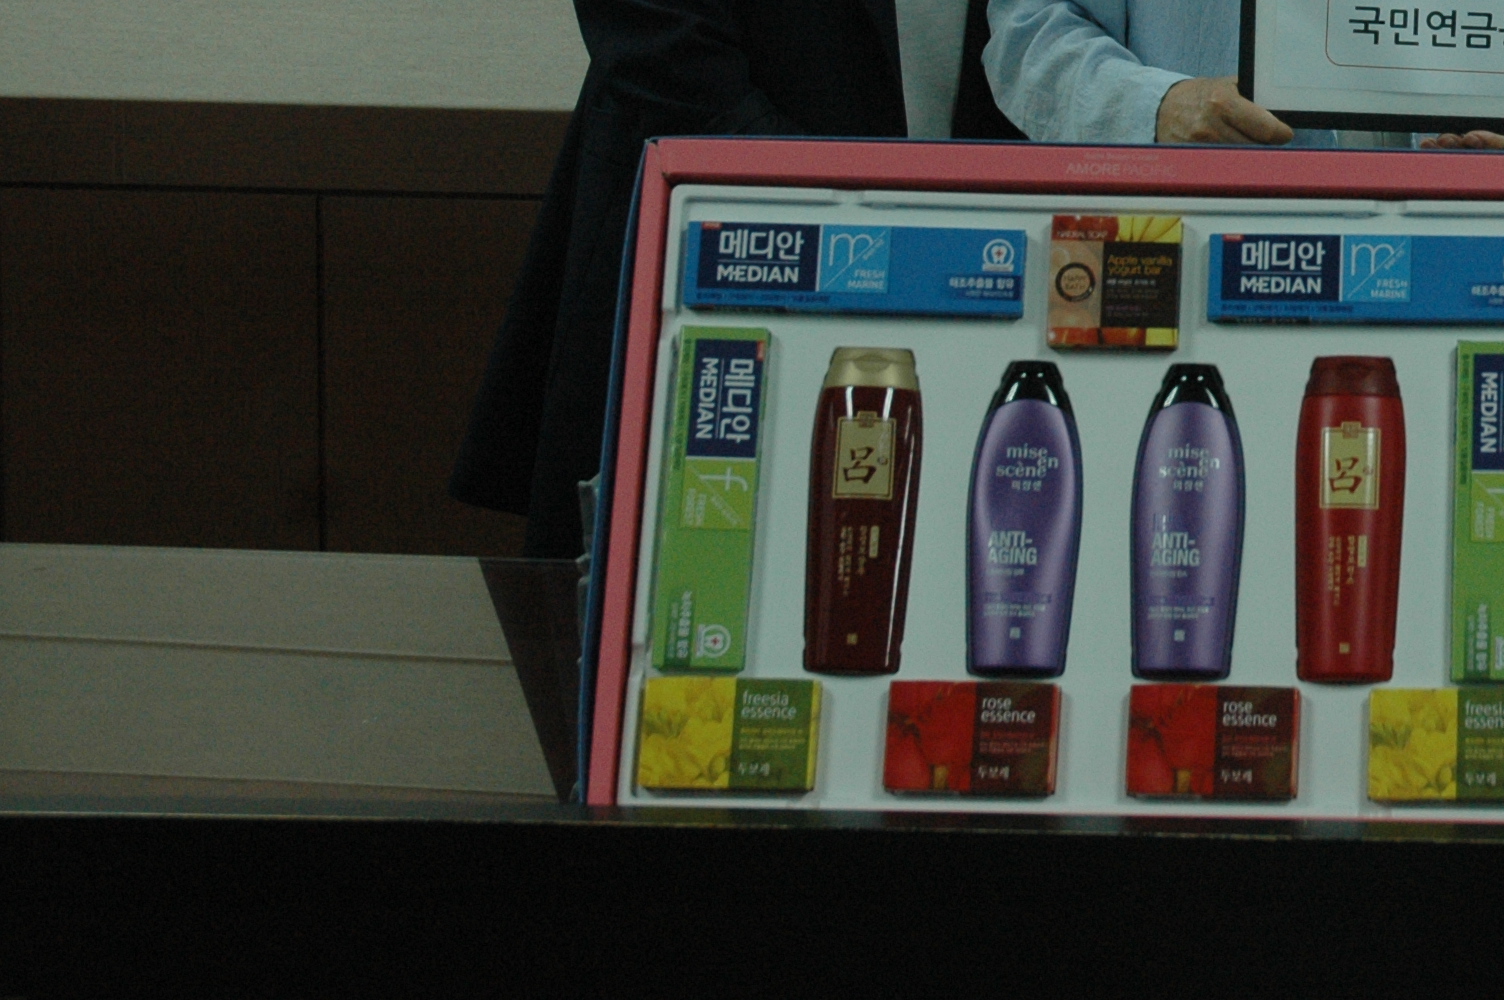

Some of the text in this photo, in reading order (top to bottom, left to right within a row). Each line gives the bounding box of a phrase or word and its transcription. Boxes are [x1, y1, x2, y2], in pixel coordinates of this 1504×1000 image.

[718, 229, 805, 260] 메디안
[1240, 240, 1326, 272] 메디안
[716, 264, 800, 284] MEDIAN
[1239, 275, 1322, 294] MEDIAN
[695, 357, 720, 440] MEDIAN
[721, 358, 755, 443] 메디안
[1480, 371, 1498, 453] MEDIAN
[1006, 442, 1049, 459] mise
[1168, 442, 1209, 459] mise
[1037, 456, 1059, 469] en
[1199, 456, 1220, 469] en
[988, 531, 1033, 548] ANTI-
[1152, 532, 1196, 549] ANTI-
[987, 548, 1038, 565] AGING
[1150, 548, 1200, 566] AGING
[742, 689, 789, 706] freesia
[981, 696, 1012, 710] rose
[740, 704, 797, 720] essence
[1222, 699, 1253, 714] rose
[980, 708, 1036, 723] essence
[1222, 712, 1278, 728] essence
